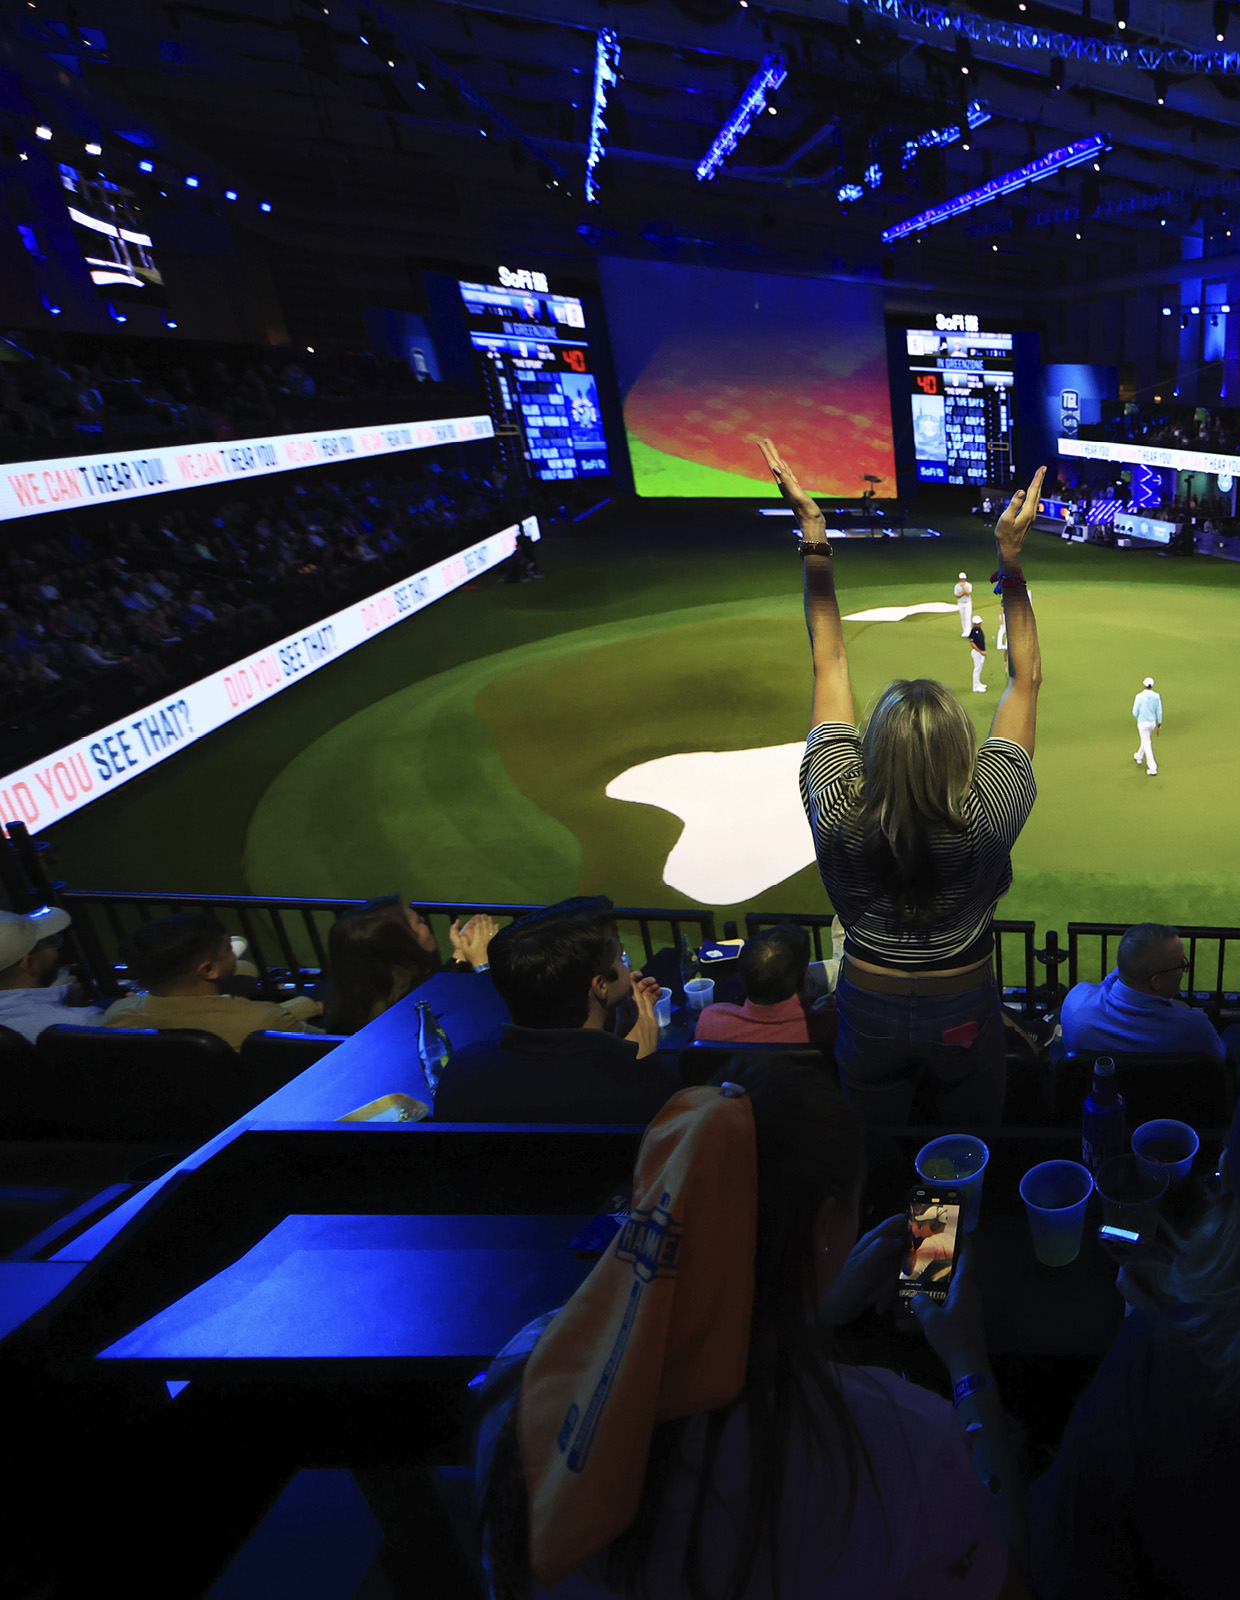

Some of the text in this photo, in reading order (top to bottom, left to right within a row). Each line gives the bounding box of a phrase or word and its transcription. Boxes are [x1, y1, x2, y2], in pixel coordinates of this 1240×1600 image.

[498, 266, 534, 291] SoFi
[936, 313, 964, 331] SoFi
[562, 350, 586, 372] 40
[917, 375, 937, 394] 40
[7, 473, 46, 507] WE
[43, 465, 96, 502] CAN'T
[91, 461, 137, 494] HEAR
[222, 669, 254, 708] DID
[249, 653, 282, 693] YOU
[278, 640, 306, 678] SEE
[34, 752, 93, 810] YOU
[89, 729, 139, 782] SEE
[131, 698, 195, 758] THAT?
